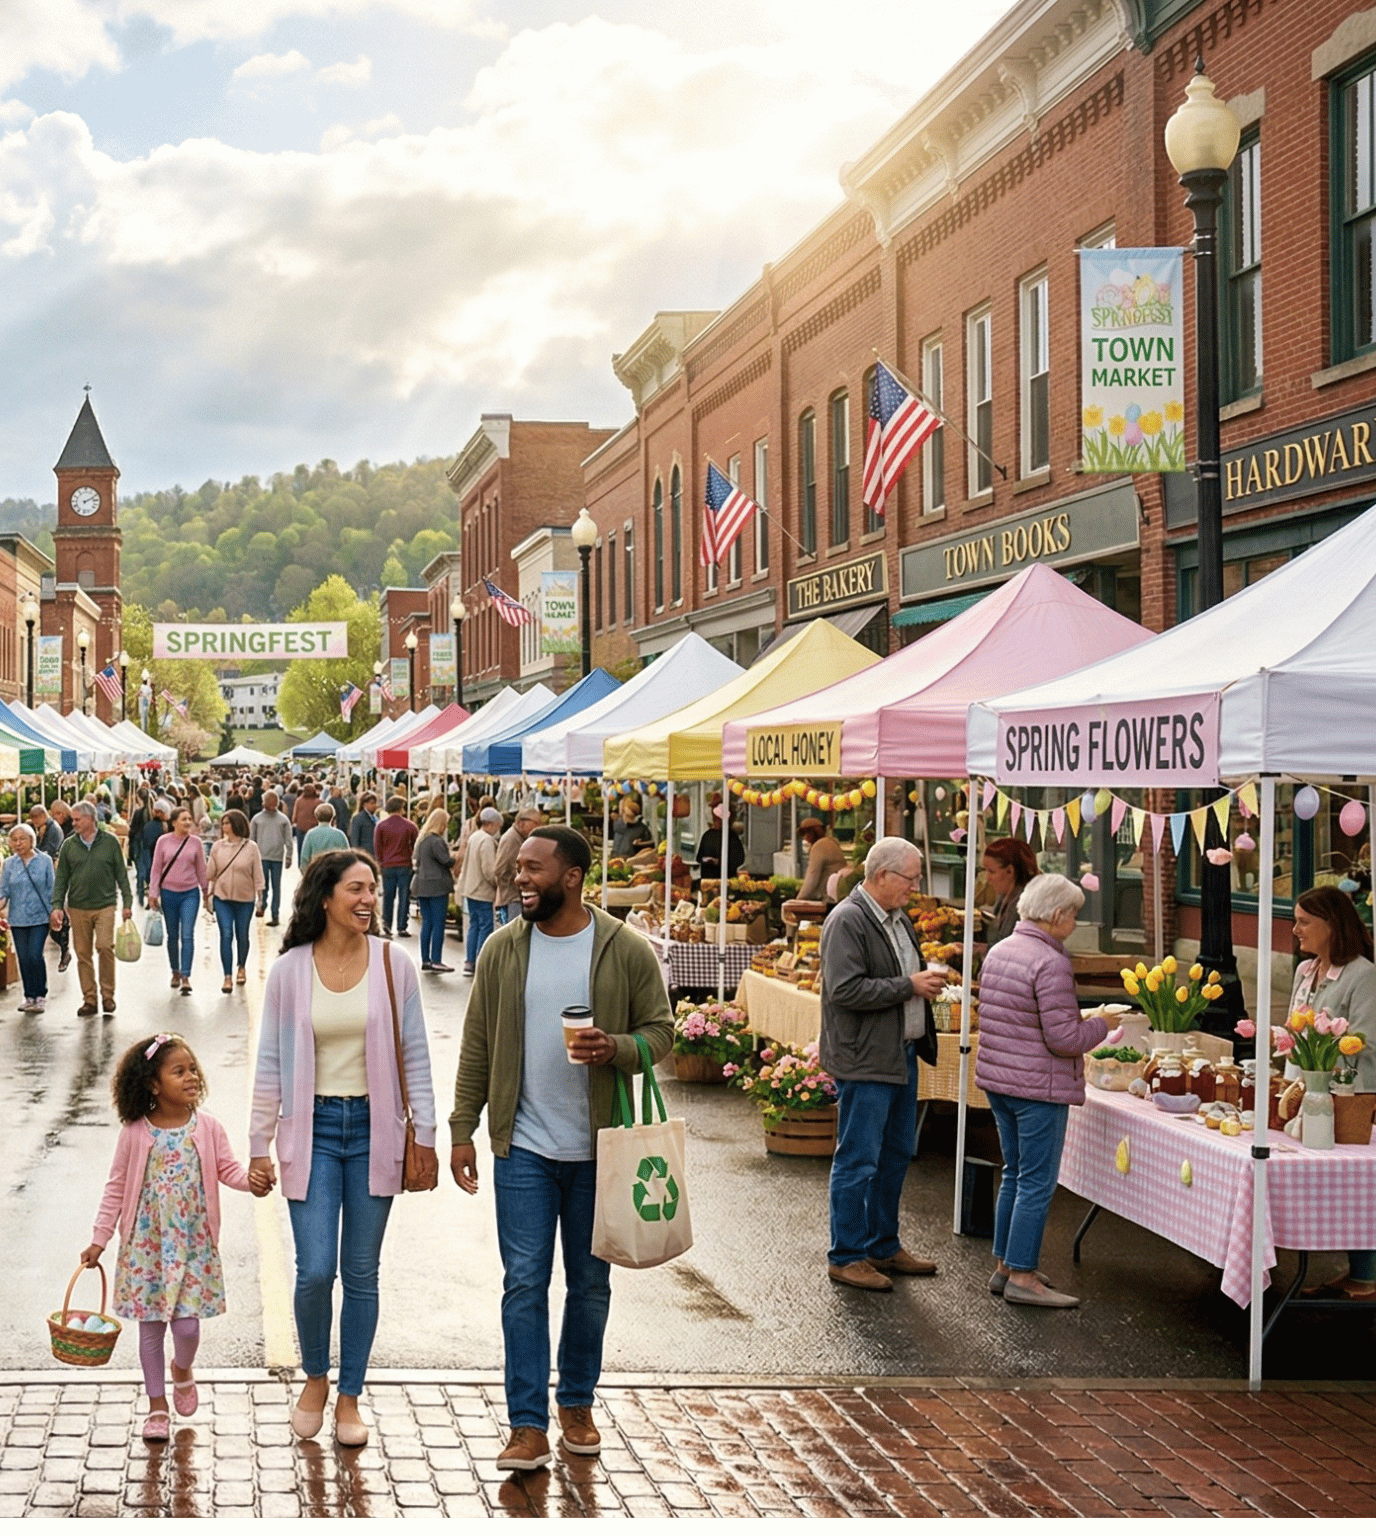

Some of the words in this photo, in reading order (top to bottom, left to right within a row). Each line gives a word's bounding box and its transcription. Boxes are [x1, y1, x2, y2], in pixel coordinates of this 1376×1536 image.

[1091, 337, 1174, 362] TOWN
[1092, 367, 1176, 387] MARKET
[1225, 417, 1376, 501] HARDWAR
[942, 535, 996, 580] TOWN
[1001, 513, 1071, 566] BOOKS
[796, 580, 821, 609] THE
[823, 560, 876, 602] BAKERY
[545, 601, 575, 611] TOWN
[166, 631, 332, 653] SPRINGFEST
[751, 734, 788, 766] LOCAL
[792, 730, 835, 765] HONEY
[1005, 721, 1079, 771] SPRING
[1088, 711, 1205, 771] FLOWERS
